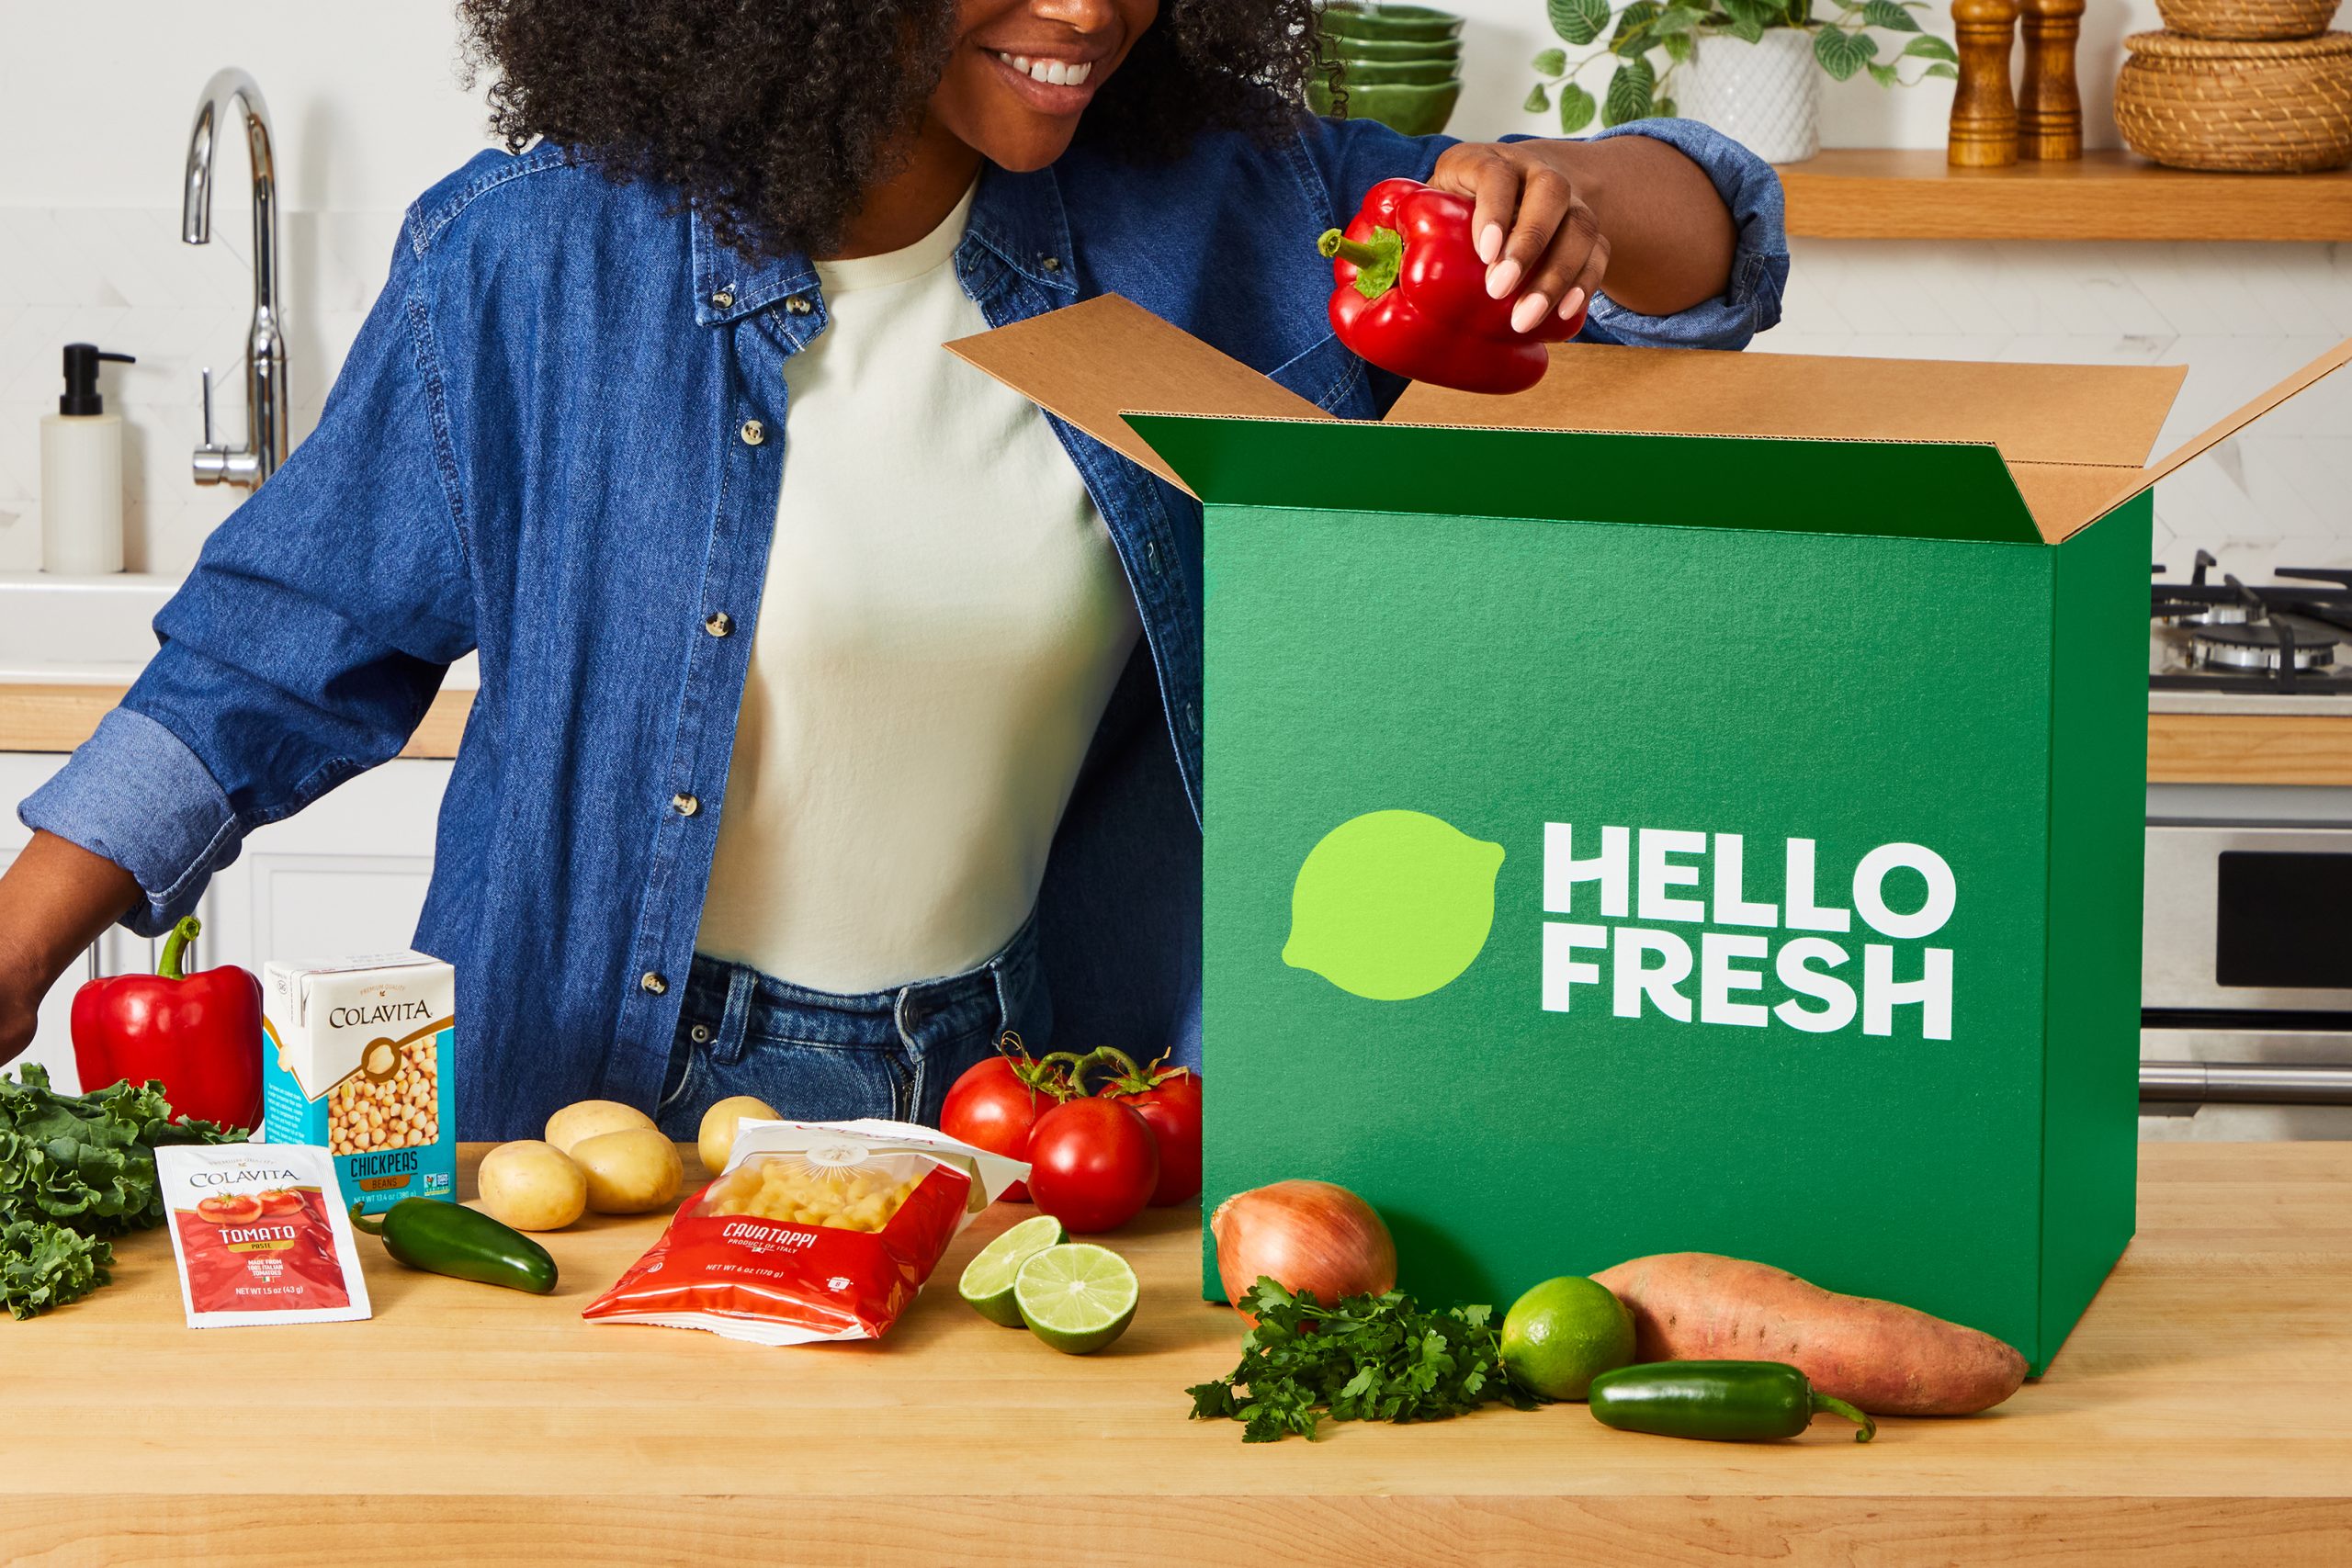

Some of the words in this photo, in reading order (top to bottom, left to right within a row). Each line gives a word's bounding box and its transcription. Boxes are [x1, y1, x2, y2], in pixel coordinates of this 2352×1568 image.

[1543, 821, 1957, 939] HELLO
[1542, 921, 1954, 1041] FRESH
[329, 999, 432, 1029] COLAVITA
[351, 1151, 418, 1178] CHICKPEAS
[189, 1169, 301, 1188] COLAVITA
[372, 1178, 398, 1190] BEANS
[353, 1195, 365, 1204] NET
[366, 1194, 376, 1202] WT
[376, 1193, 388, 1201] 13.4
[218, 1225, 296, 1245] TOMATO
[722, 1223, 818, 1248] CAVATAPPI
[728, 1238, 764, 1247] PRODUCT
[776, 1246, 798, 1254] ITALY
[755, 1268, 773, 1276] (170
[235, 1287, 249, 1295] NET
[296, 1286, 304, 1294] g)
